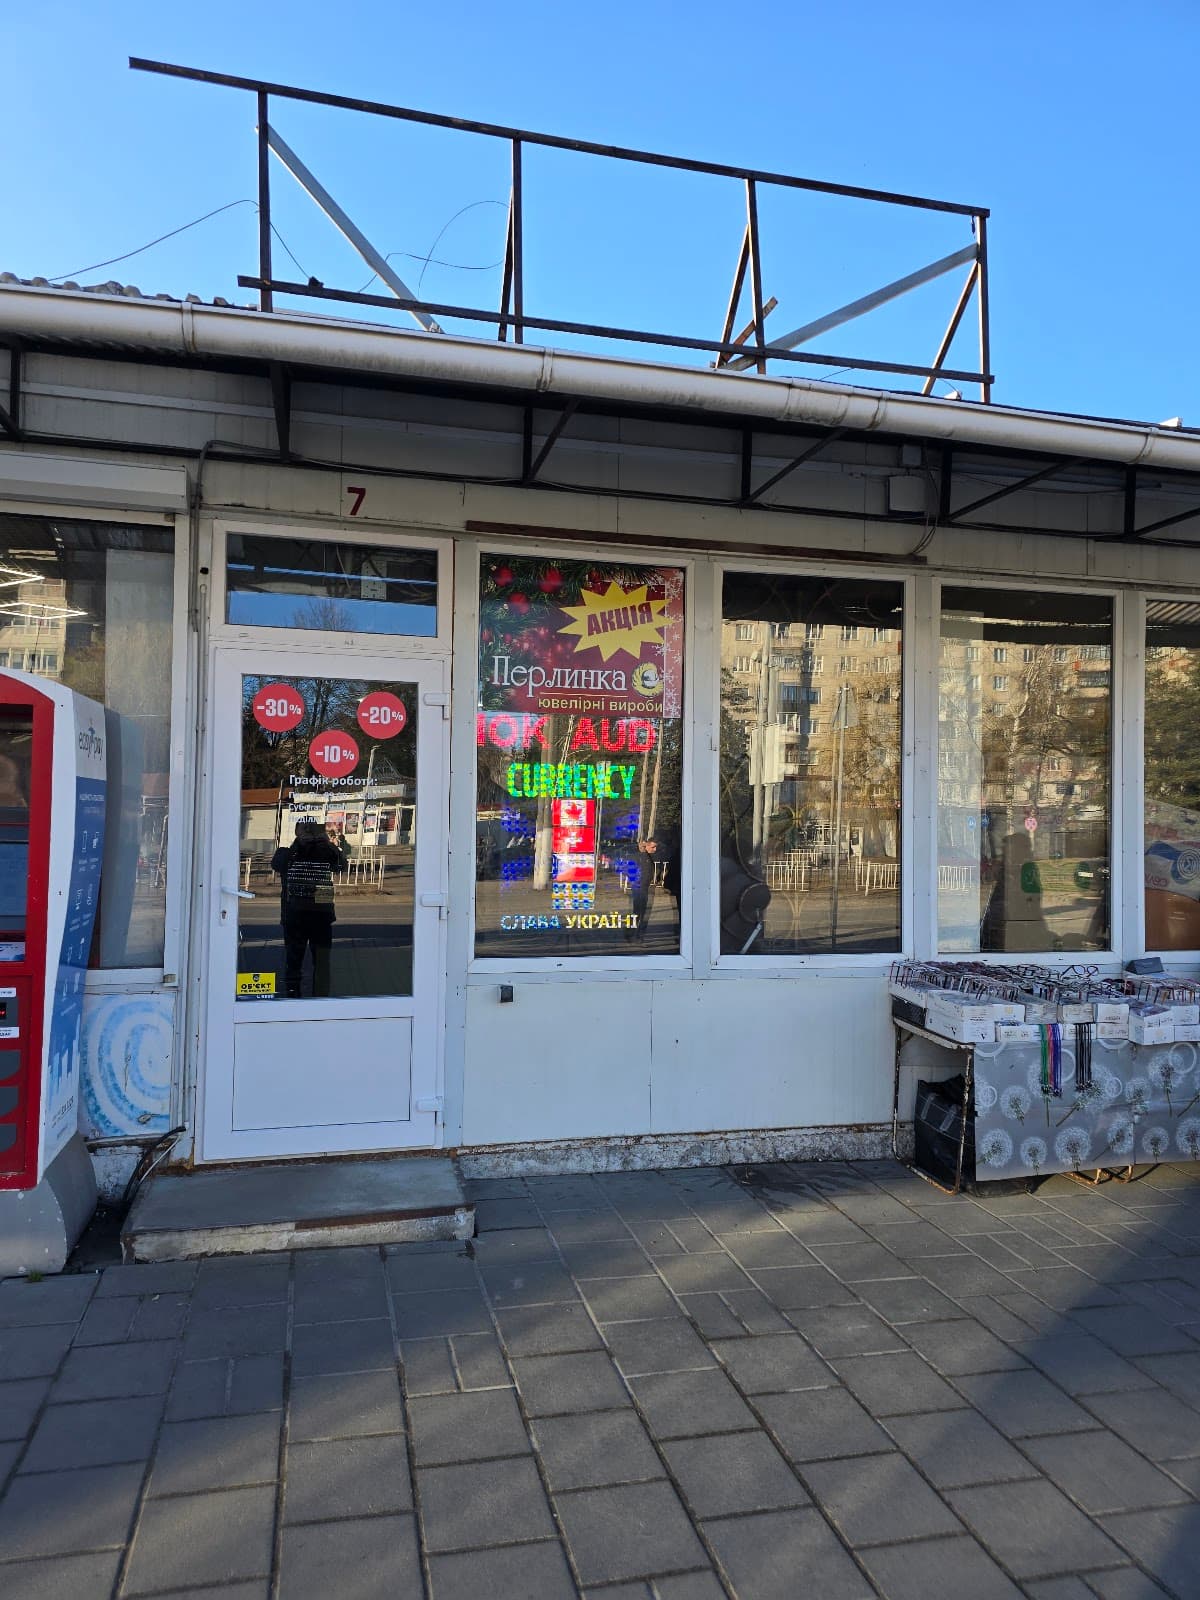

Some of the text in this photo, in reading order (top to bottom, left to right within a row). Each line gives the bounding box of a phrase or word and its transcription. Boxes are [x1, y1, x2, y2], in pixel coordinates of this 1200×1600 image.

[347, 487, 366, 516] 7
[587, 602, 653, 636] АКЦІЯ
[492, 655, 627, 698] Перлинка
[256, 698, 302, 717] -30%
[538, 697, 662, 714] ювелірні вироби
[361, 706, 404, 725] -20%
[570, 717, 656, 752] AUD
[315, 745, 355, 763] -10%
[289, 774, 378, 787] Графік роботи:
[506, 762, 636, 799] CURRENCY
[500, 911, 638, 930] СЛАВА УКРАЇНІ
